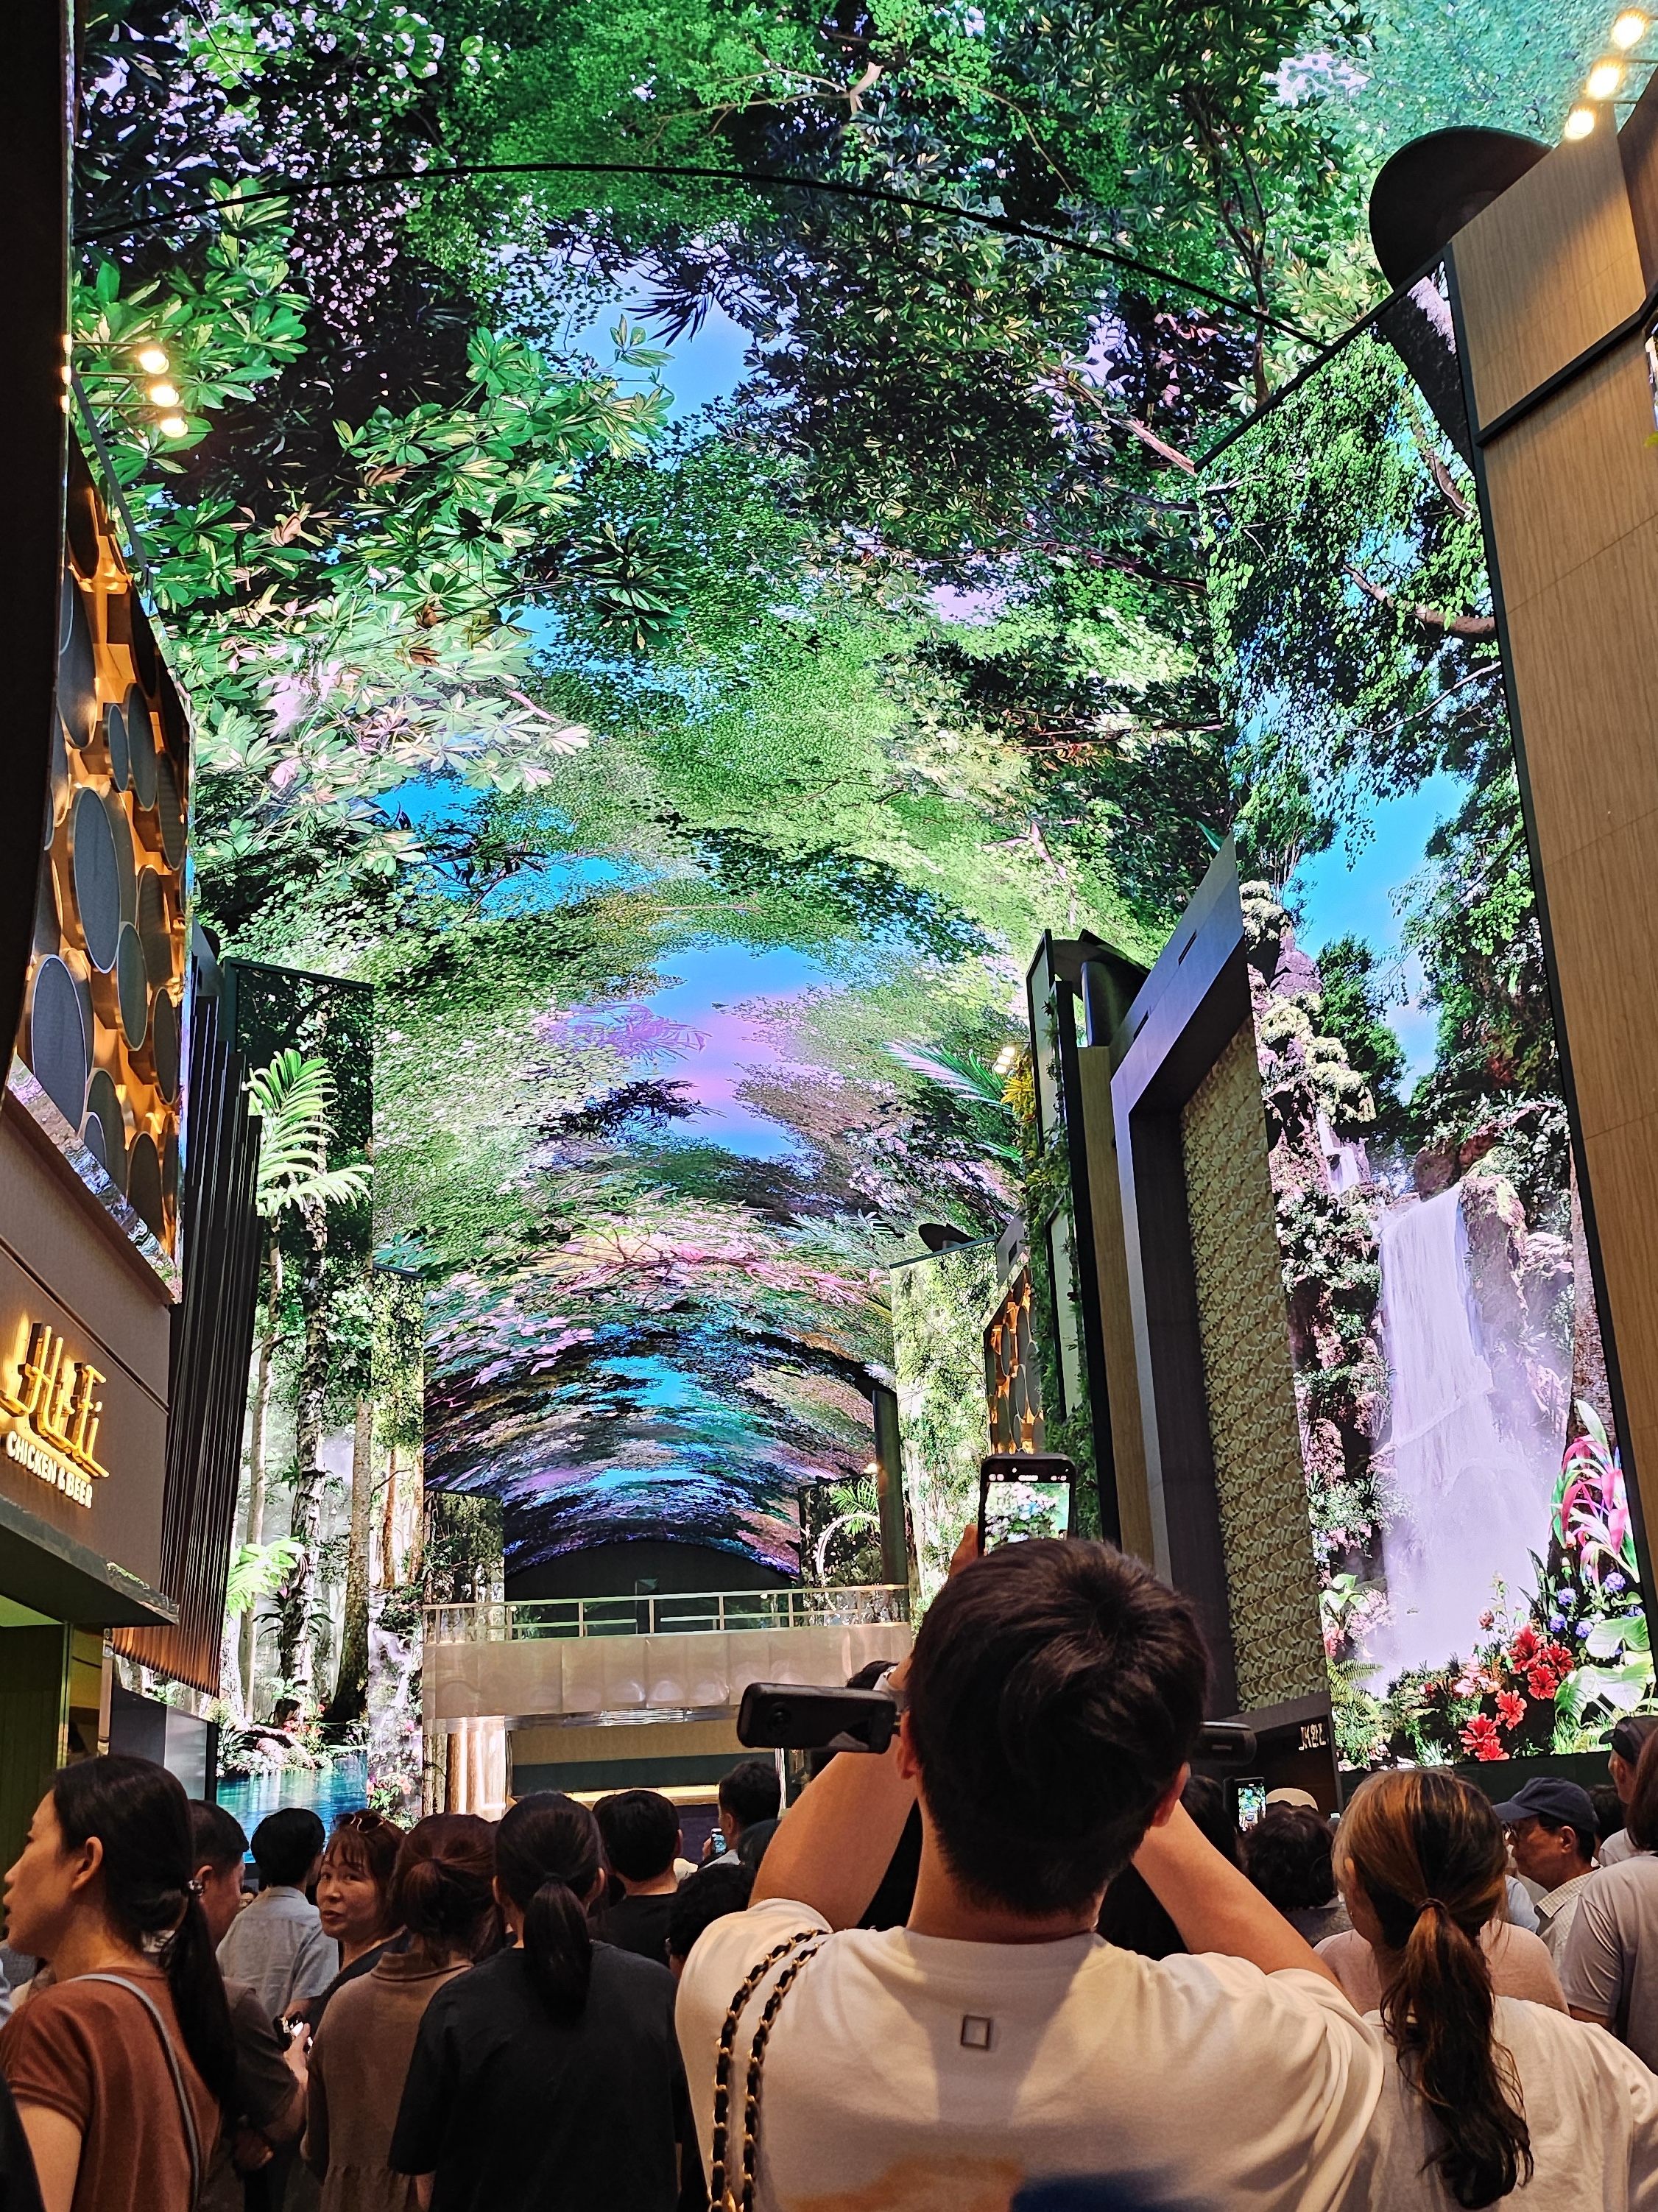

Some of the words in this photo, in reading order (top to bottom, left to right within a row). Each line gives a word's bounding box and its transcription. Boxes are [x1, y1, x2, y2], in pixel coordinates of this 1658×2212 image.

[7, 1431, 57, 1484] CHICKEN
[58, 1470, 66, 1491] &
[66, 1475, 93, 1509] BEER
